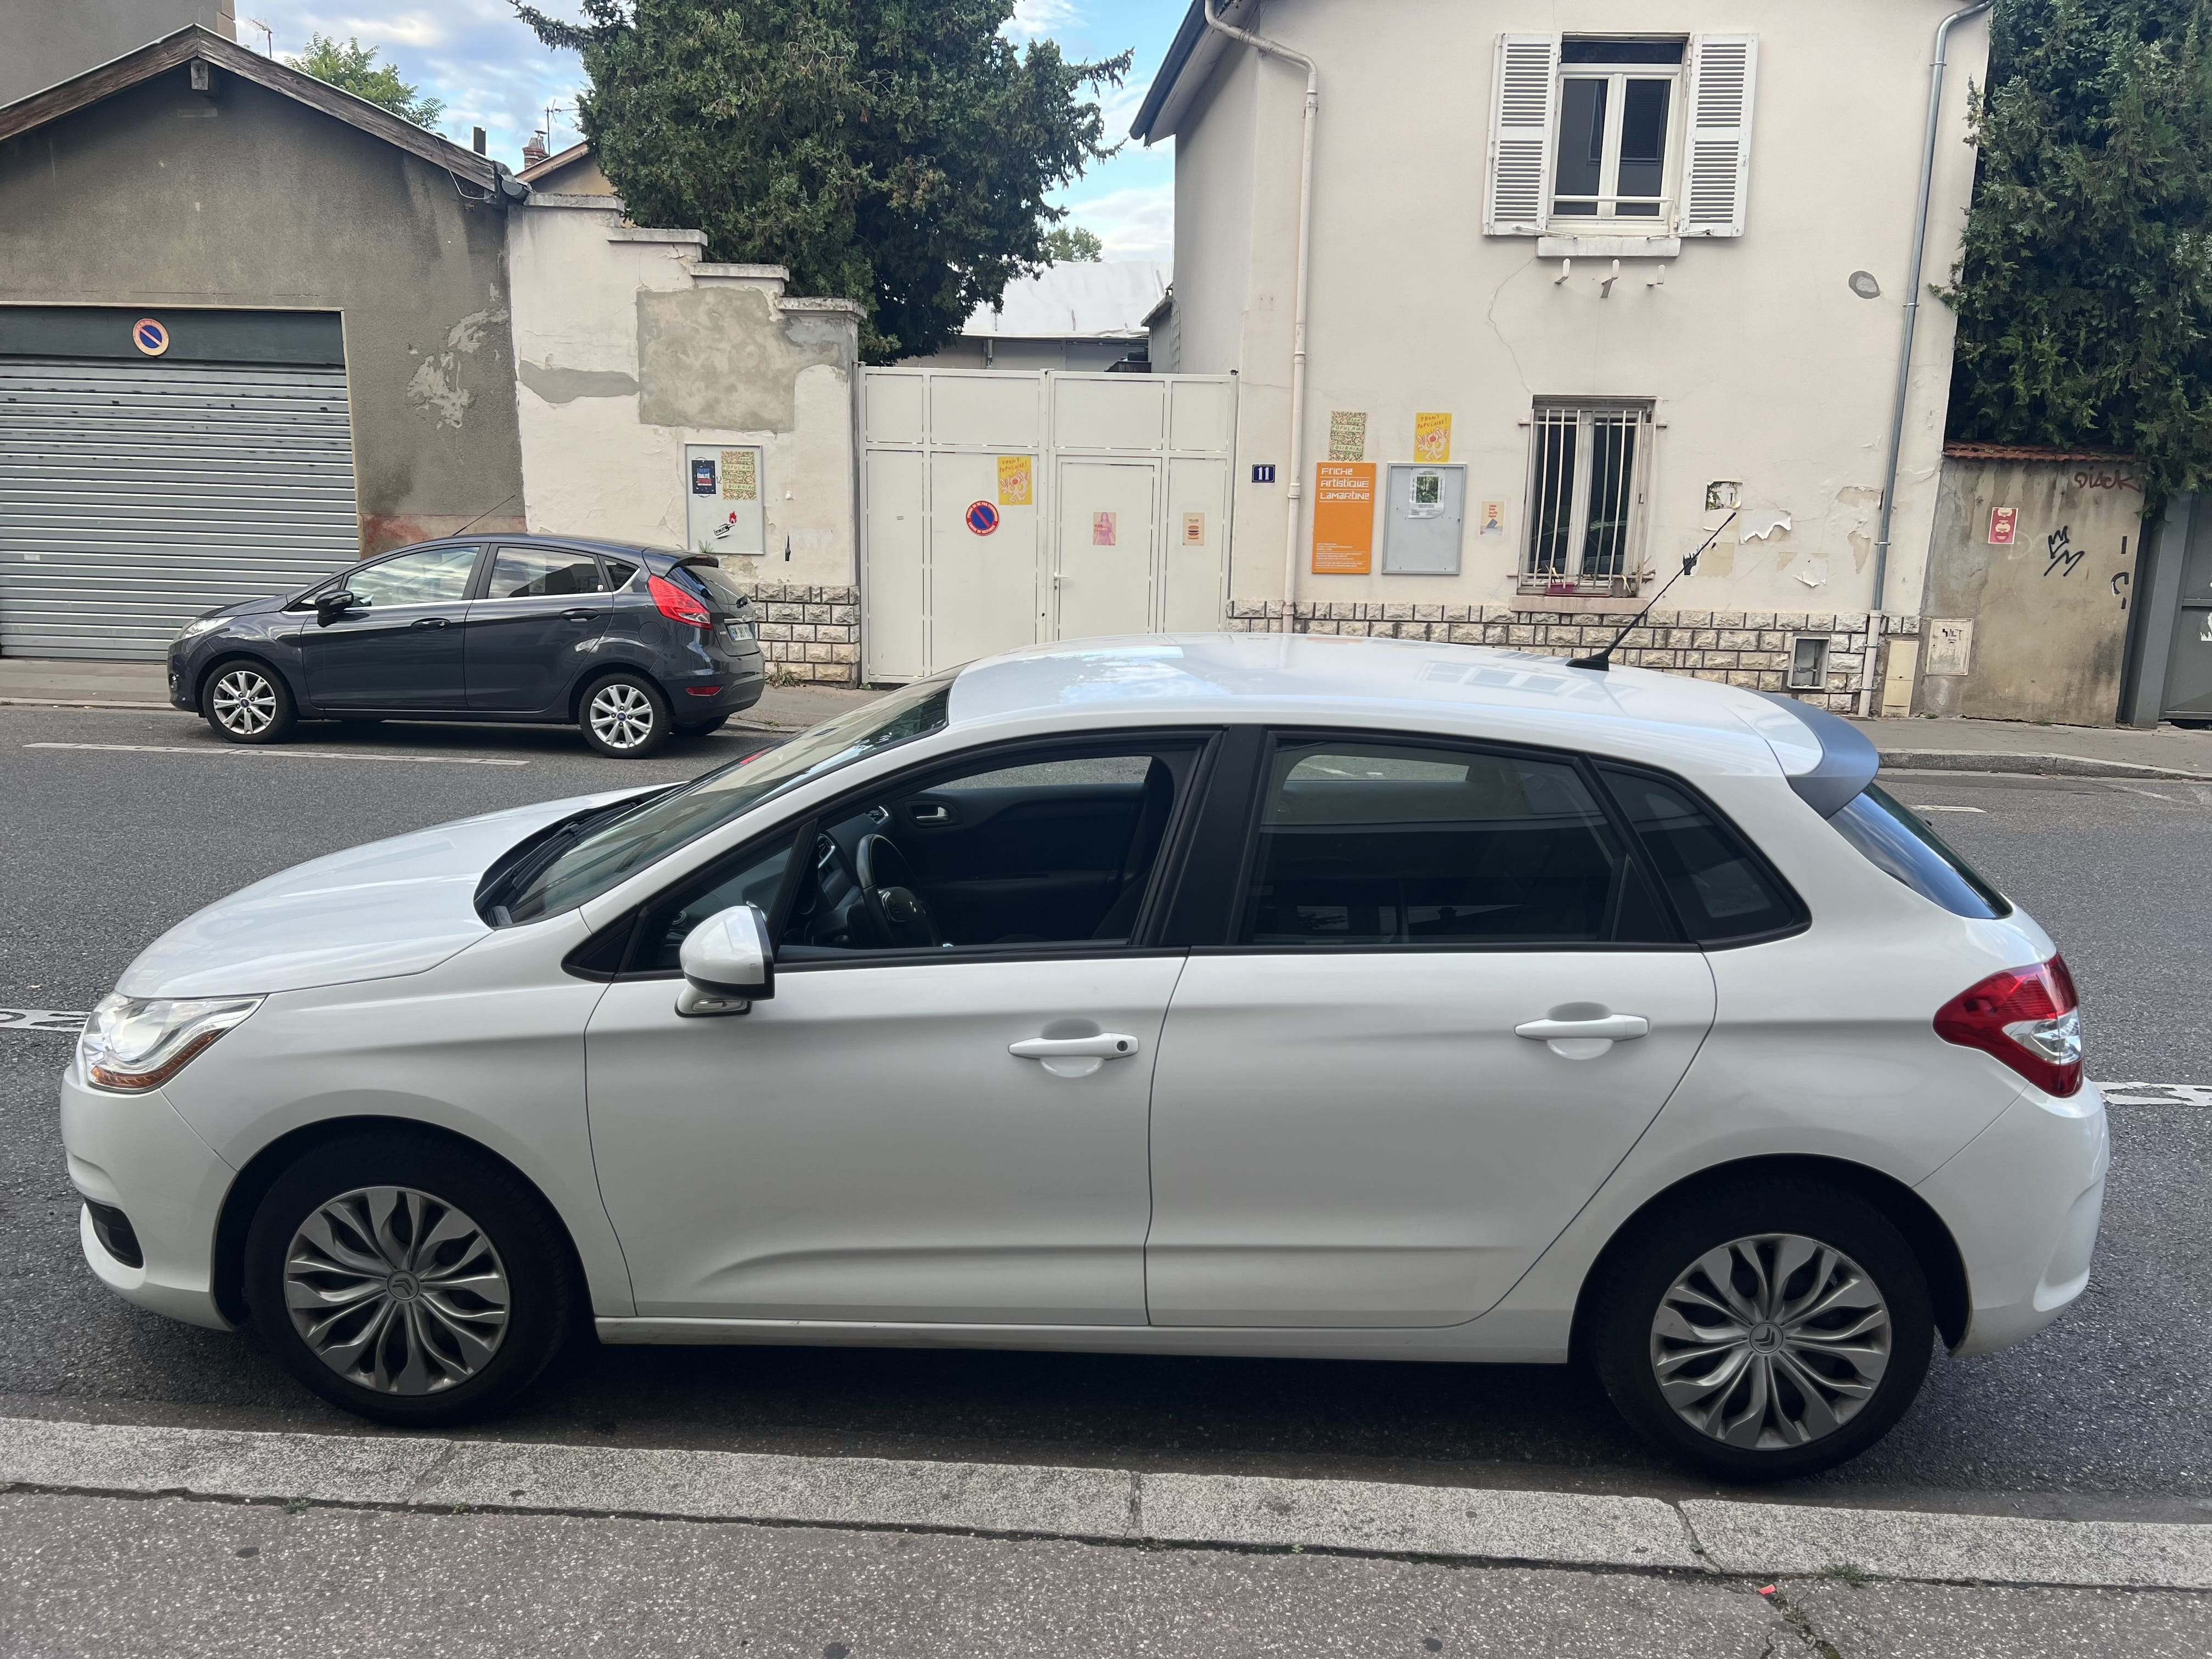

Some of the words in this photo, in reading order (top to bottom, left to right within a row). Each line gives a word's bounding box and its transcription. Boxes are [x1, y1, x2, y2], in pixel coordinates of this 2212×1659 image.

[1421, 414, 1440, 422] FRONT
[1002, 457, 1020, 465] FRONT
[1257, 467, 1269, 480] 11
